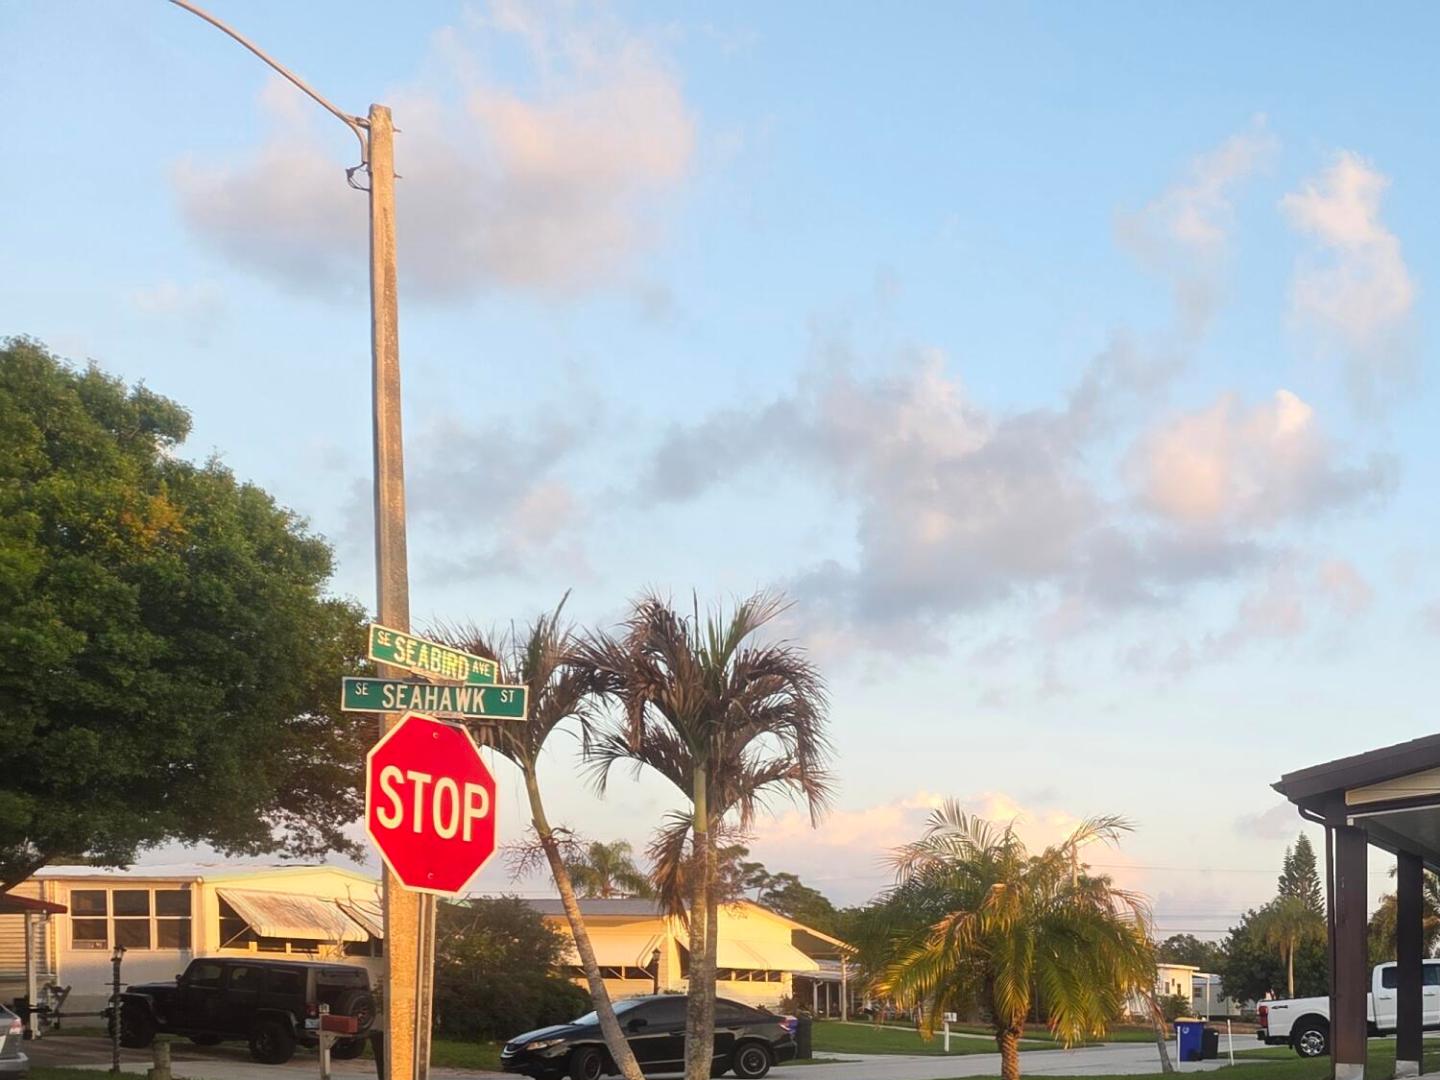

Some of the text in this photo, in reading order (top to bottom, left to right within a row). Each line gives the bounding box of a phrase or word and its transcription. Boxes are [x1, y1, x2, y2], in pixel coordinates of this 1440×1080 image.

[377, 630, 491, 680] SE SEABIRD AVE
[355, 682, 515, 713] SE SEAHAWK ST
[376, 765, 490, 842] STOP
